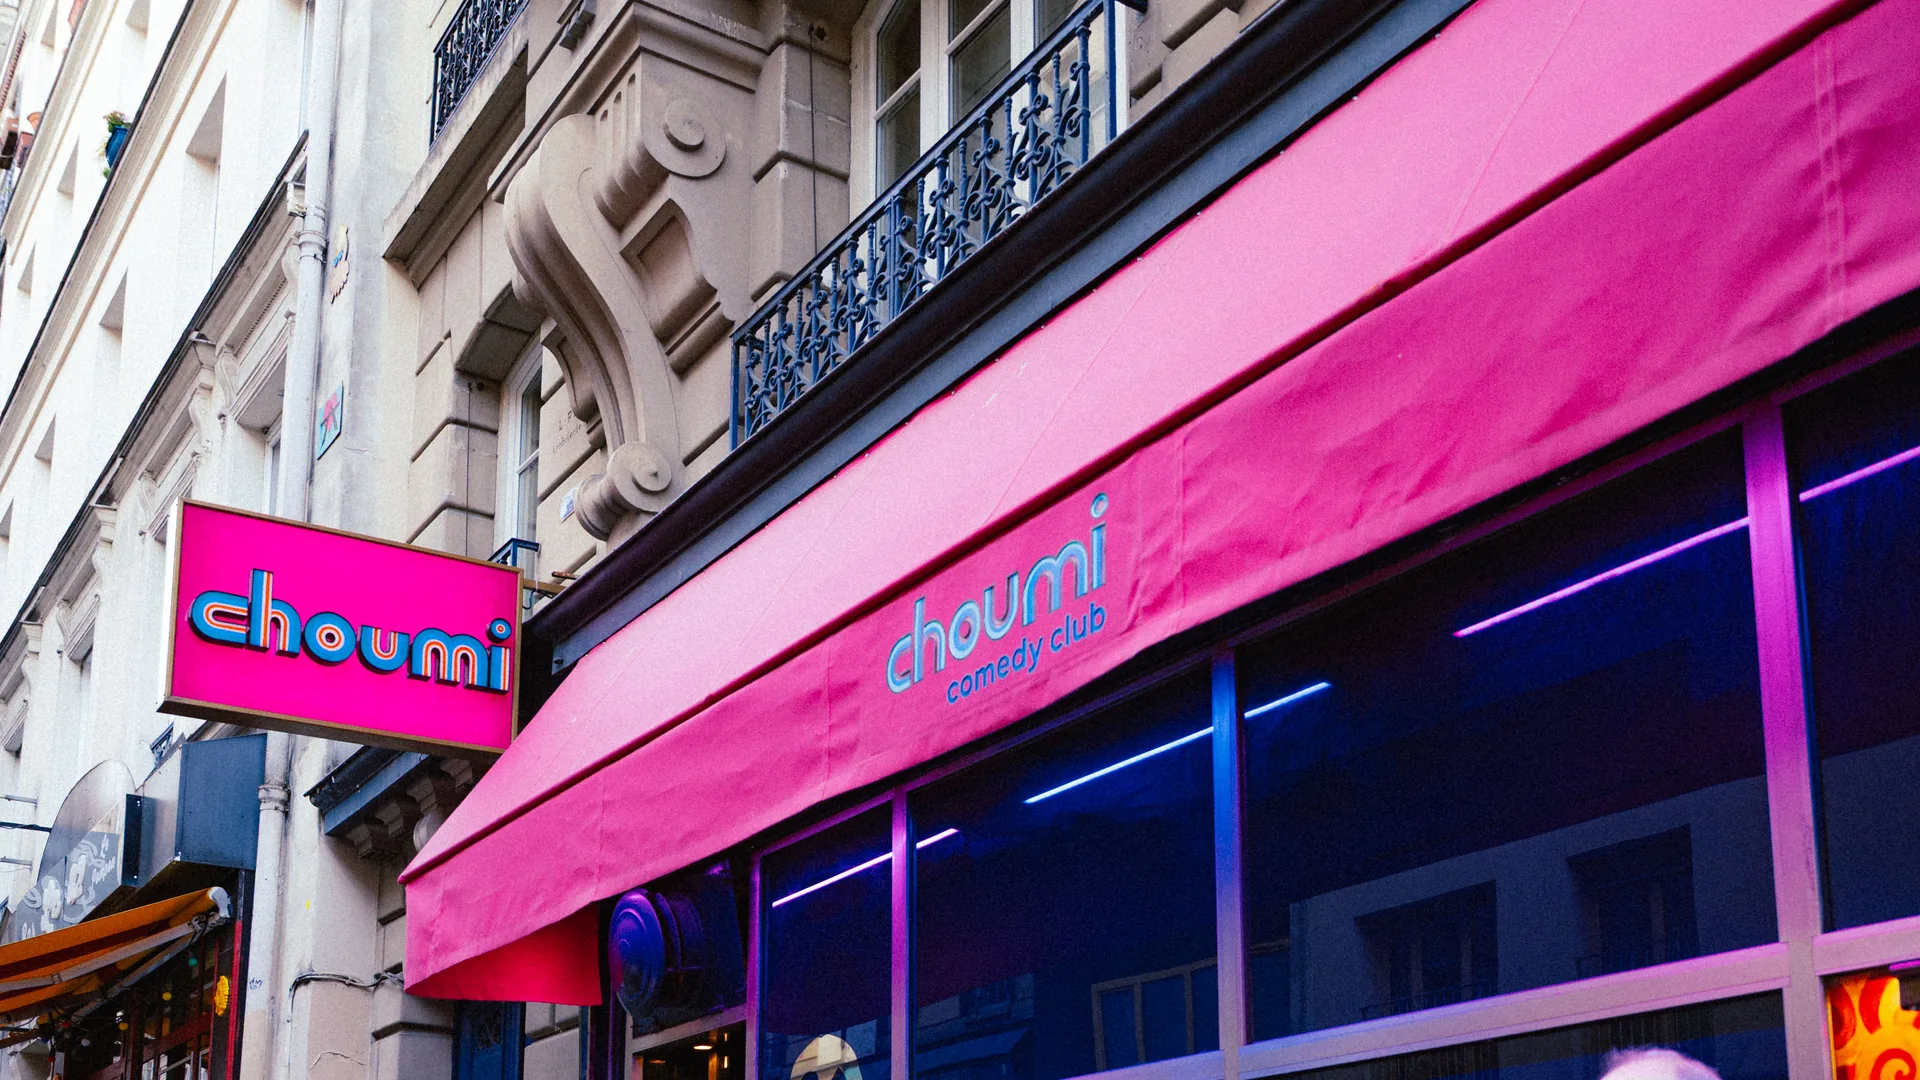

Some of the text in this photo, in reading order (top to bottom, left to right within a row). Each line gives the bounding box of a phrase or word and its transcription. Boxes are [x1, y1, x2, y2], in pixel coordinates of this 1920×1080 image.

[188, 568, 512, 694] choumi
[886, 492, 1109, 694] choumi
[946, 602, 1106, 704] comedy club
